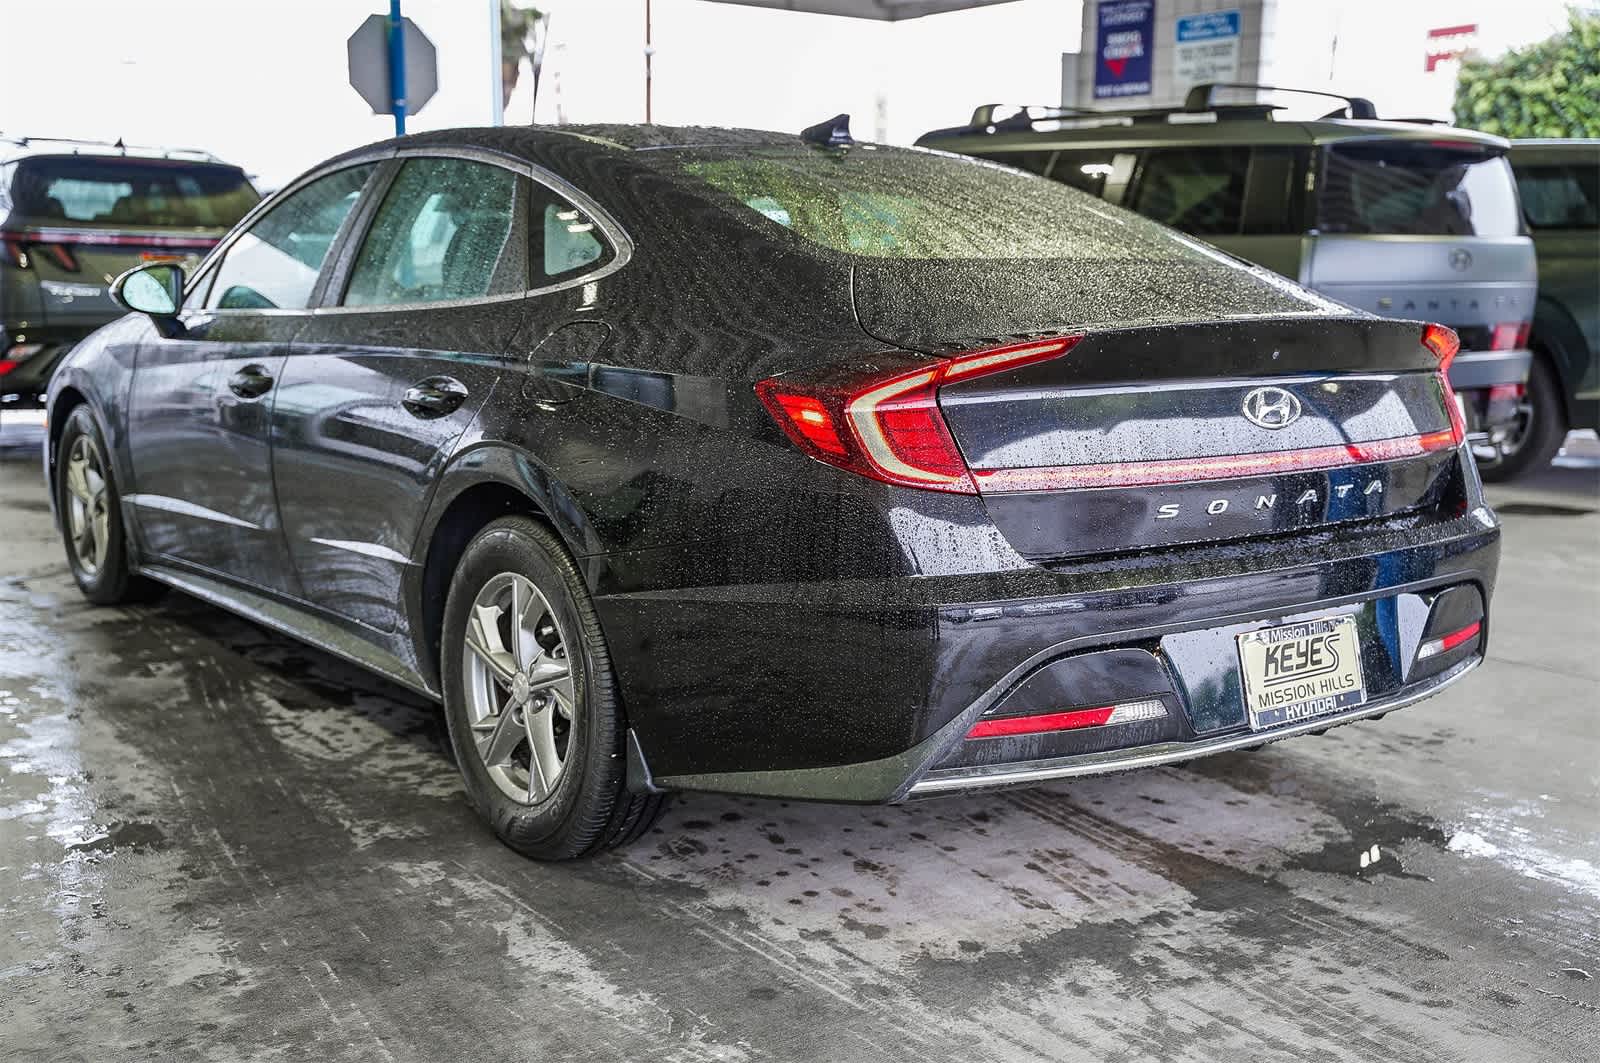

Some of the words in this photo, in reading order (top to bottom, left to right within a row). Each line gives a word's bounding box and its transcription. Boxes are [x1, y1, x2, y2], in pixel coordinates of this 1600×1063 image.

[1156, 479, 1384, 519] SONATA
[1271, 626, 1306, 644] Mission
[1308, 620, 1329, 636] Hills
[1264, 633, 1341, 677] KEYES
[1258, 682, 1316, 708] MISSION
[1320, 673, 1355, 694] HILLS
[1285, 696, 1337, 720] HYUNDAI
